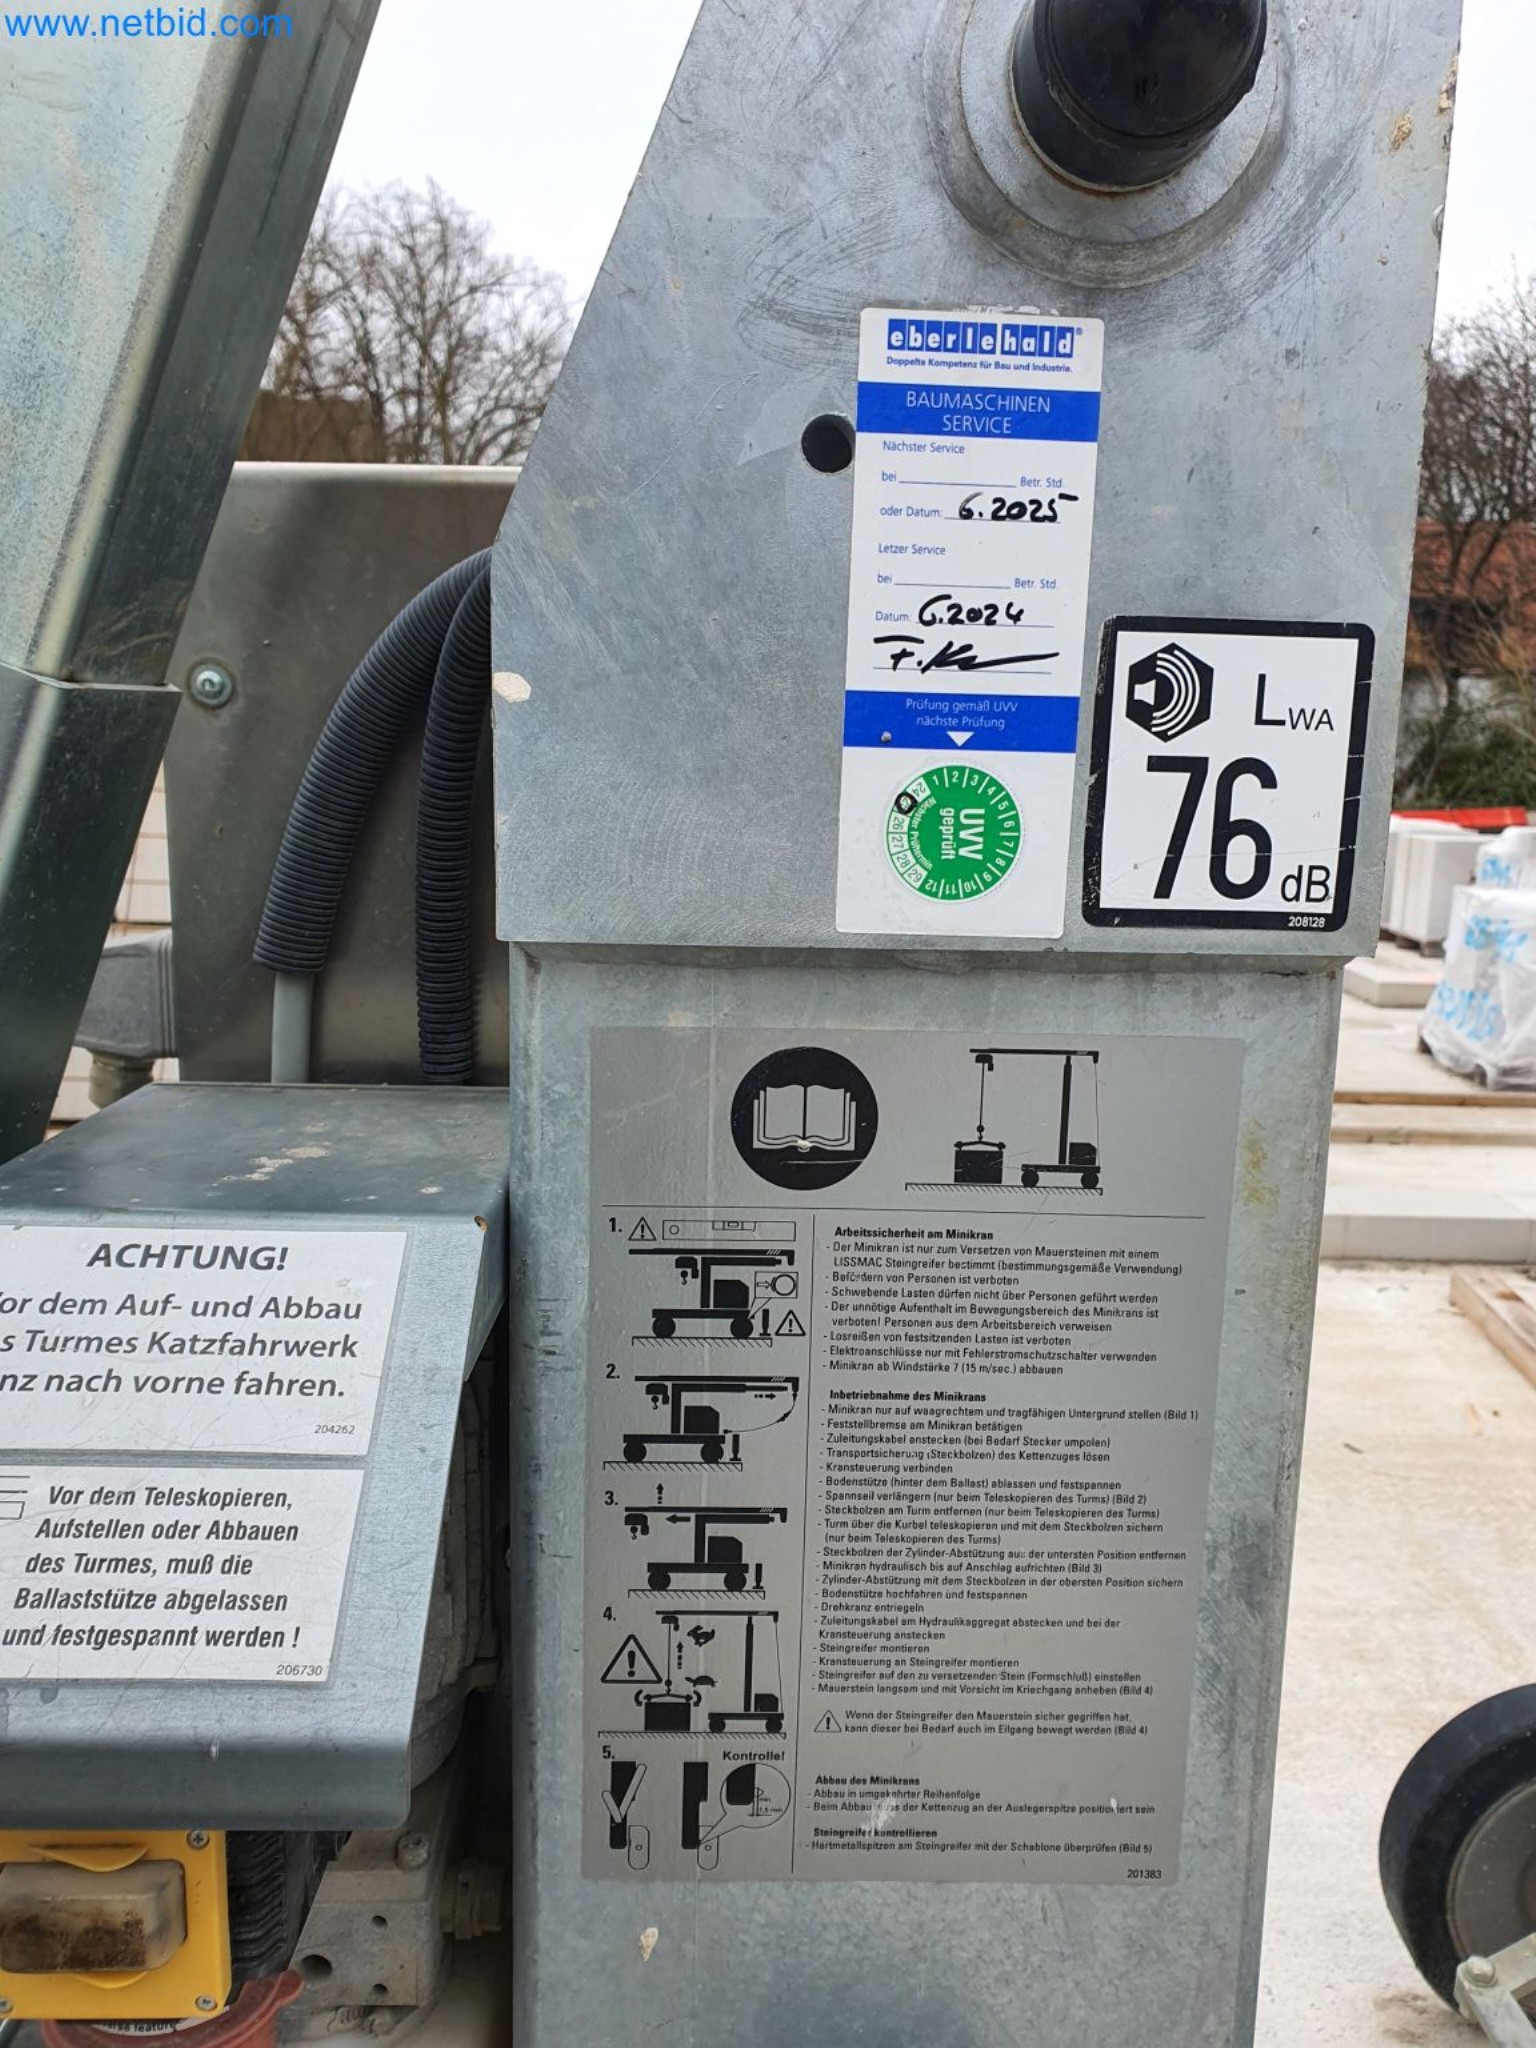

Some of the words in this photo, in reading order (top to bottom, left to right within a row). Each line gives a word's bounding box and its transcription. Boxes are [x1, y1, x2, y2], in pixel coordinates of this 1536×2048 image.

[886, 355, 926, 367] Doppelte
[927, 357, 978, 369] Kompetenz
[979, 360, 992, 369] für
[994, 360, 1011, 370] Bau
[1012, 362, 1030, 371] und
[1032, 362, 1072, 373] Industrie.
[906, 391, 1050, 413] BAUMASCHINEN
[942, 414, 1012, 434] SERVICE
[882, 439, 927, 453] Nächster
[929, 441, 965, 454] Service
[881, 471, 896, 482] bei
[1020, 477, 1042, 488] Betr.
[1046, 477, 1063, 488] Std.
[880, 507, 903, 518] oder
[906, 506, 942, 519] Datum:
[878, 543, 909, 554] Letzer
[911, 543, 946, 555] Service
[877, 573, 892, 584] bei
[1014, 578, 1036, 589] Betr.
[875, 611, 910, 622] Datum:
[918, 594, 1024, 627] 6.2024
[905, 697, 949, 714] Prüfung
[952, 699, 990, 714] gemäß
[993, 700, 1018, 712] UVV
[916, 715, 959, 727] nächste
[961, 715, 1005, 731] Prüfung
[952, 771, 959, 782] 2
[971, 775, 979, 786] 3
[987, 786, 996, 796] 4
[998, 801, 1009, 810] 5
[892, 816, 904, 831] 26
[1003, 820, 1015, 829] 6
[1146, 755, 1278, 900] 76
[939, 807, 956, 860] geprüft
[892, 835, 904, 849] 27
[1003, 840, 1014, 848] 7
[897, 853, 910, 869] 28
[996, 858, 1006, 867] 8
[908, 869, 922, 883] 29
[983, 871, 992, 882] 9
[1280, 864, 1331, 904] dB
[1288, 916, 1325, 929] 208128
[608, 1217, 622, 1233] 1.
[834, 1226, 925, 1239] Arbeitssicherheit
[927, 1230, 943, 1239] am
[945, 1228, 993, 1240] Minikran
[87, 1243, 289, 1272] ACHTUNG!
[832, 1240, 852, 1252] Der
[853, 1241, 899, 1253] Minikran
[901, 1242, 914, 1254] ist
[916, 1245, 934, 1254] nur
[936, 1245, 957, 1254] zum
[959, 1244, 1011, 1255] Versetzen
[1013, 1248, 1032, 1256] von
[1035, 1245, 1107, 1258] Mauersteinen
[1108, 1247, 1126, 1259] mit
[1127, 1248, 1159, 1259] einem
[833, 1256, 882, 1268] LISSMAC
[885, 1256, 945, 1271] Steingreifer
[948, 1258, 995, 1270] bestimmt
[997, 1259, 1111, 1275] (bestimmungsgemäße
[1113, 1262, 1182, 1277] Verwendung)
[831, 1285, 898, 1298] Schwebende
[901, 1287, 935, 1298] Lasten
[937, 1288, 971, 1299] dürfen
[973, 1288, 1000, 1300] nicht
[1002, 1289, 1026, 1300] über
[1028, 1289, 1077, 1302] Personen
[1079, 1291, 1117, 1304] geführt
[1118, 1292, 1158, 1304] werden
[0, 1291, 33, 1315] or
[38, 1292, 107, 1317] dem
[116, 1293, 182, 1318] Auf-
[191, 1295, 253, 1319] und
[260, 1296, 362, 1321] Abbau
[25, 1330, 138, 1354] Turmes
[147, 1331, 358, 1359] Katzfahrwerk
[829, 1344, 922, 1357] Elektroanschlüsse
[924, 1349, 942, 1358] nur
[944, 1347, 960, 1358] mit
[962, 1347, 1097, 1361] Fehlerstromschutzschalter
[1100, 1351, 1157, 1362] verwenden
[606, 1363, 620, 1379] 2.
[44, 1369, 122, 1394] nach
[133, 1375, 224, 1395] vorne
[233, 1371, 345, 1398] fahren.
[829, 1389, 910, 1401] Inbetriebnahme
[912, 1390, 931, 1401] des
[933, 1390, 986, 1402] Minikrans
[828, 1403, 872, 1415] Minikran
[875, 1406, 892, 1415] nur
[894, 1404, 911, 1415] auf
[913, 1406, 983, 1418] waagrechtem
[986, 1407, 1005, 1417] und
[1007, 1407, 1066, 1420] tragfähigen
[1068, 1408, 1126, 1421] Untergrund
[1127, 1408, 1161, 1420] stellen
[1163, 1409, 1187, 1421] (Bild
[1190, 1409, 1199, 1422] 1)
[314, 1424, 355, 1436] 204262
[825, 1461, 900, 1475] Kransteuerung
[902, 1462, 953, 1474] verbinden
[49, 1487, 83, 1505] Vor
[90, 1487, 135, 1506] dem
[144, 1487, 293, 1511] Teleskopieren,
[604, 1490, 619, 1506] 3.
[35, 1519, 145, 1540] Aufstellen
[152, 1520, 201, 1540] oder
[205, 1521, 299, 1542] Abbauen
[25, 1553, 64, 1574] des
[73, 1553, 157, 1577] Turmes,
[167, 1555, 213, 1575] muß
[220, 1555, 253, 1576] die
[13, 1587, 157, 1610] Ballaststütze
[163, 1590, 288, 1615] abgelassen
[820, 1601, 872, 1612] Drehkranz
[874, 1602, 924, 1615] entriegeln
[602, 1607, 617, 1622] 4.
[2, 1625, 46, 1646] und
[51, 1625, 198, 1651] festgespannt
[204, 1626, 284, 1648] werden
[818, 1628, 891, 1642] Kransteuerung
[893, 1630, 945, 1640] anstecken
[819, 1642, 877, 1655] Steingreifer
[879, 1643, 930, 1654] montieren
[276, 1665, 323, 1677] 206730
[602, 1745, 616, 1759] 5.
[723, 1751, 785, 1761] Kontrolle!
[815, 1774, 847, 1785] Abbau
[849, 1775, 867, 1785] des
[869, 1775, 920, 1786] Minikrans
[813, 1827, 872, 1839] Steingreifer
[873, 1827, 937, 1838] kontrollieren
[1127, 1869, 1162, 1880] 201383
